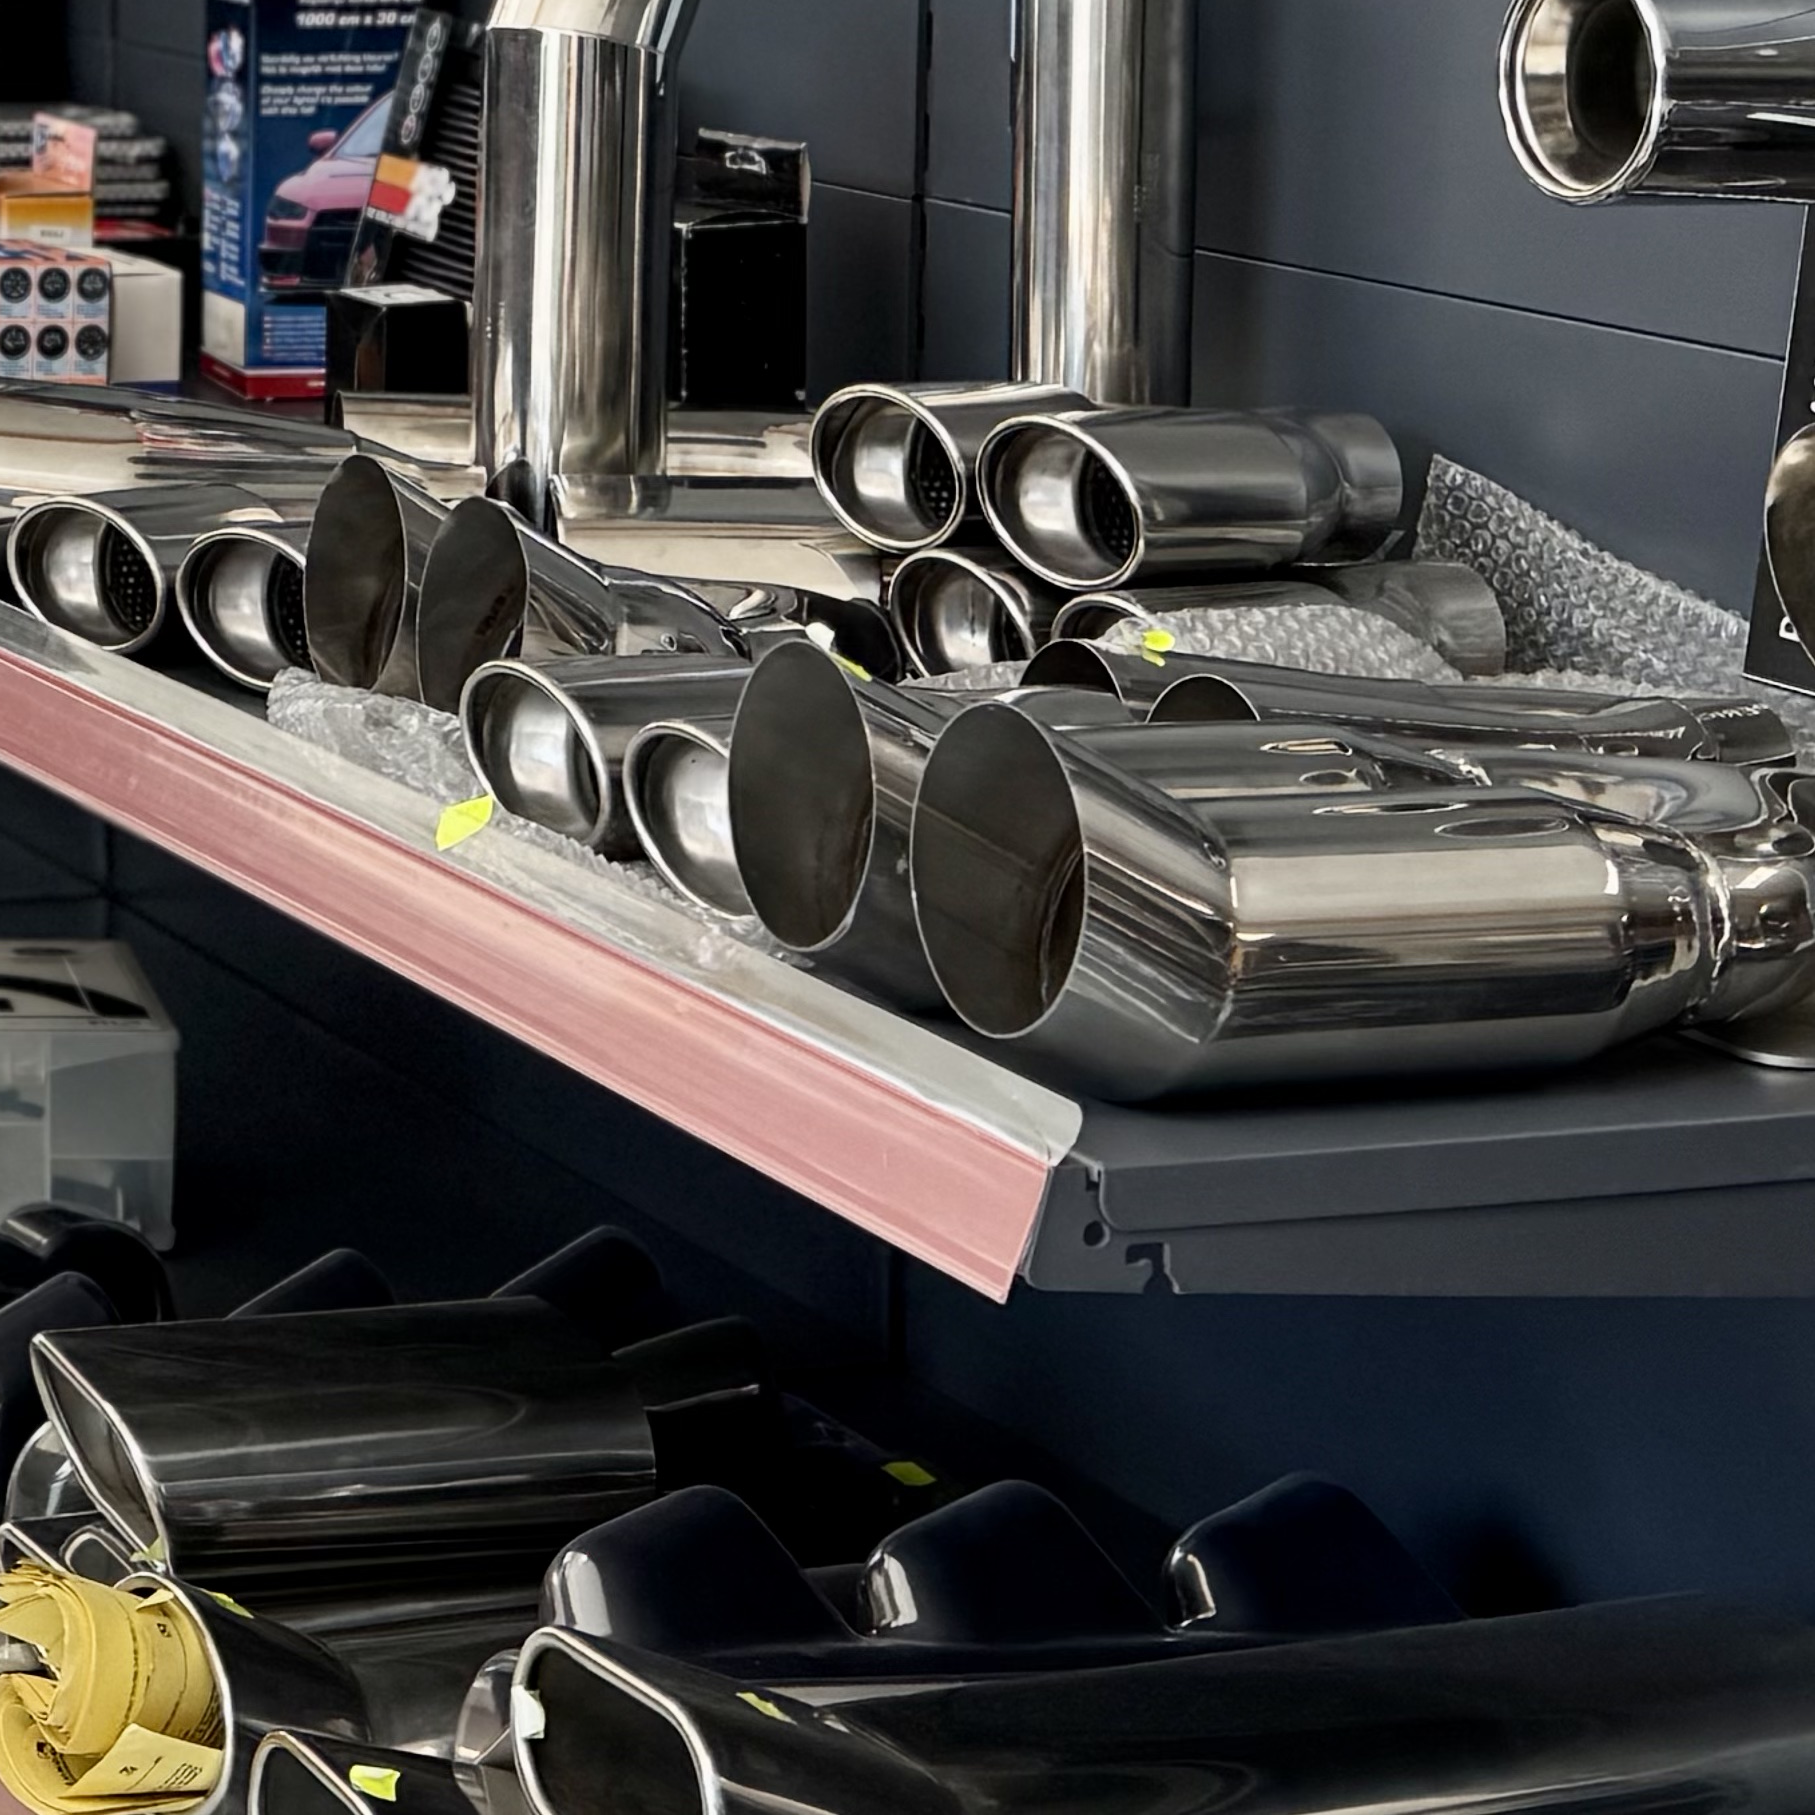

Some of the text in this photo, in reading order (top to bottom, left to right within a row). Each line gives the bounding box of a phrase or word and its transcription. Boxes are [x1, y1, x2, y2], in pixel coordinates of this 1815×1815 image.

[296, 12, 335, 27] 1000
[338, 13, 360, 26] cm
[376, 12, 397, 25] 30
